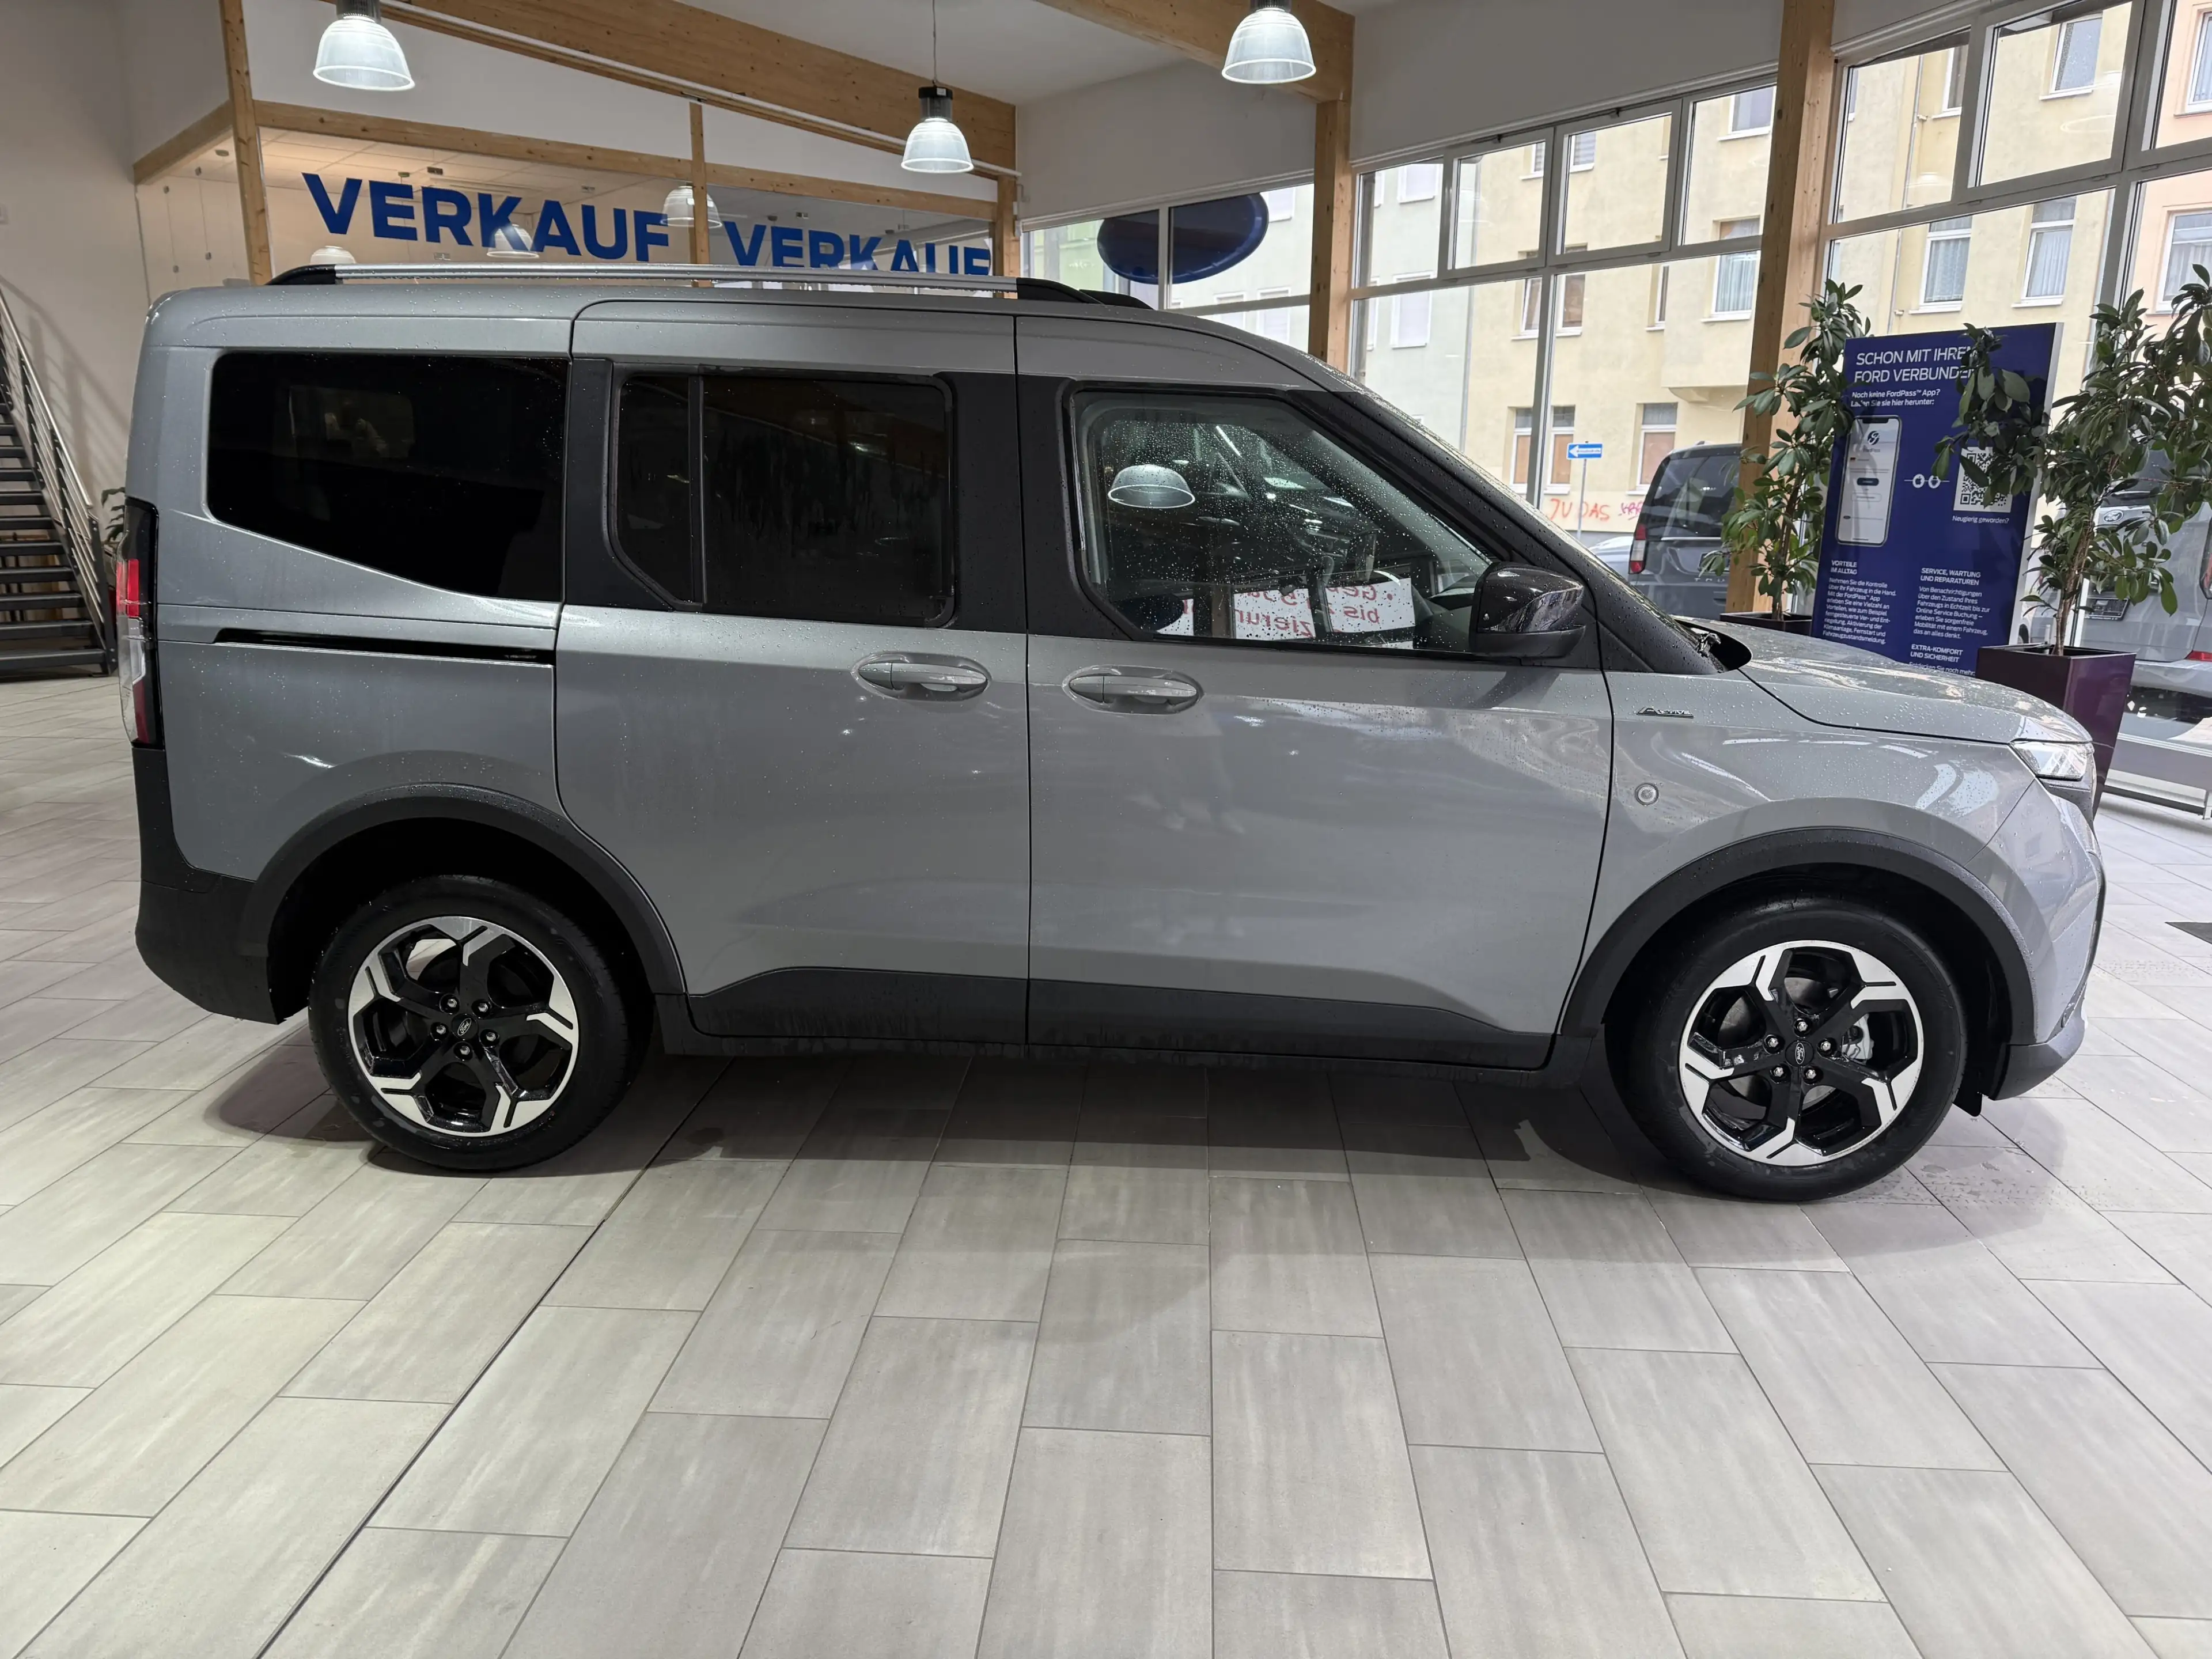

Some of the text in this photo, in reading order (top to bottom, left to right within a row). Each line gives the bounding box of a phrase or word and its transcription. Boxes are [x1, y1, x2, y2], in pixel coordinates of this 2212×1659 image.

[301, 172, 669, 262] VERKAUF
[722, 220, 991, 276] VERKAUF
[1855, 346, 1971, 365] SCHON MIT IHRE
[1854, 370, 1890, 383] FORD
[1922, 389, 1941, 397] App?
[1904, 398, 1934, 406] herunter:
[1952, 515, 1978, 523] Neugierig
[1921, 567, 1981, 578] SERVICE, WARTUNG
[1934, 576, 1979, 586] REPARATUREN
[1846, 586, 1868, 594] Fahrzeug
[1930, 586, 1982, 598] Benachrichtigungen
[1917, 600, 1944, 608] Fahrzeugs
[1950, 603, 1971, 612] Echtzeit
[1825, 611, 1858, 620] ferngesteuerte
[1953, 611, 1978, 620] Buchung
[1847, 620, 1873, 629] Aktivierung
[1944, 618, 1974, 626] sorgenfreie
[1914, 621, 1936, 629] Mobilität
[1963, 627, 1988, 636] Fahrzeug,
[1911, 643, 1963, 656] EXTRA-KOMFORT
[1924, 653, 1960, 663] SICHERHEIT
